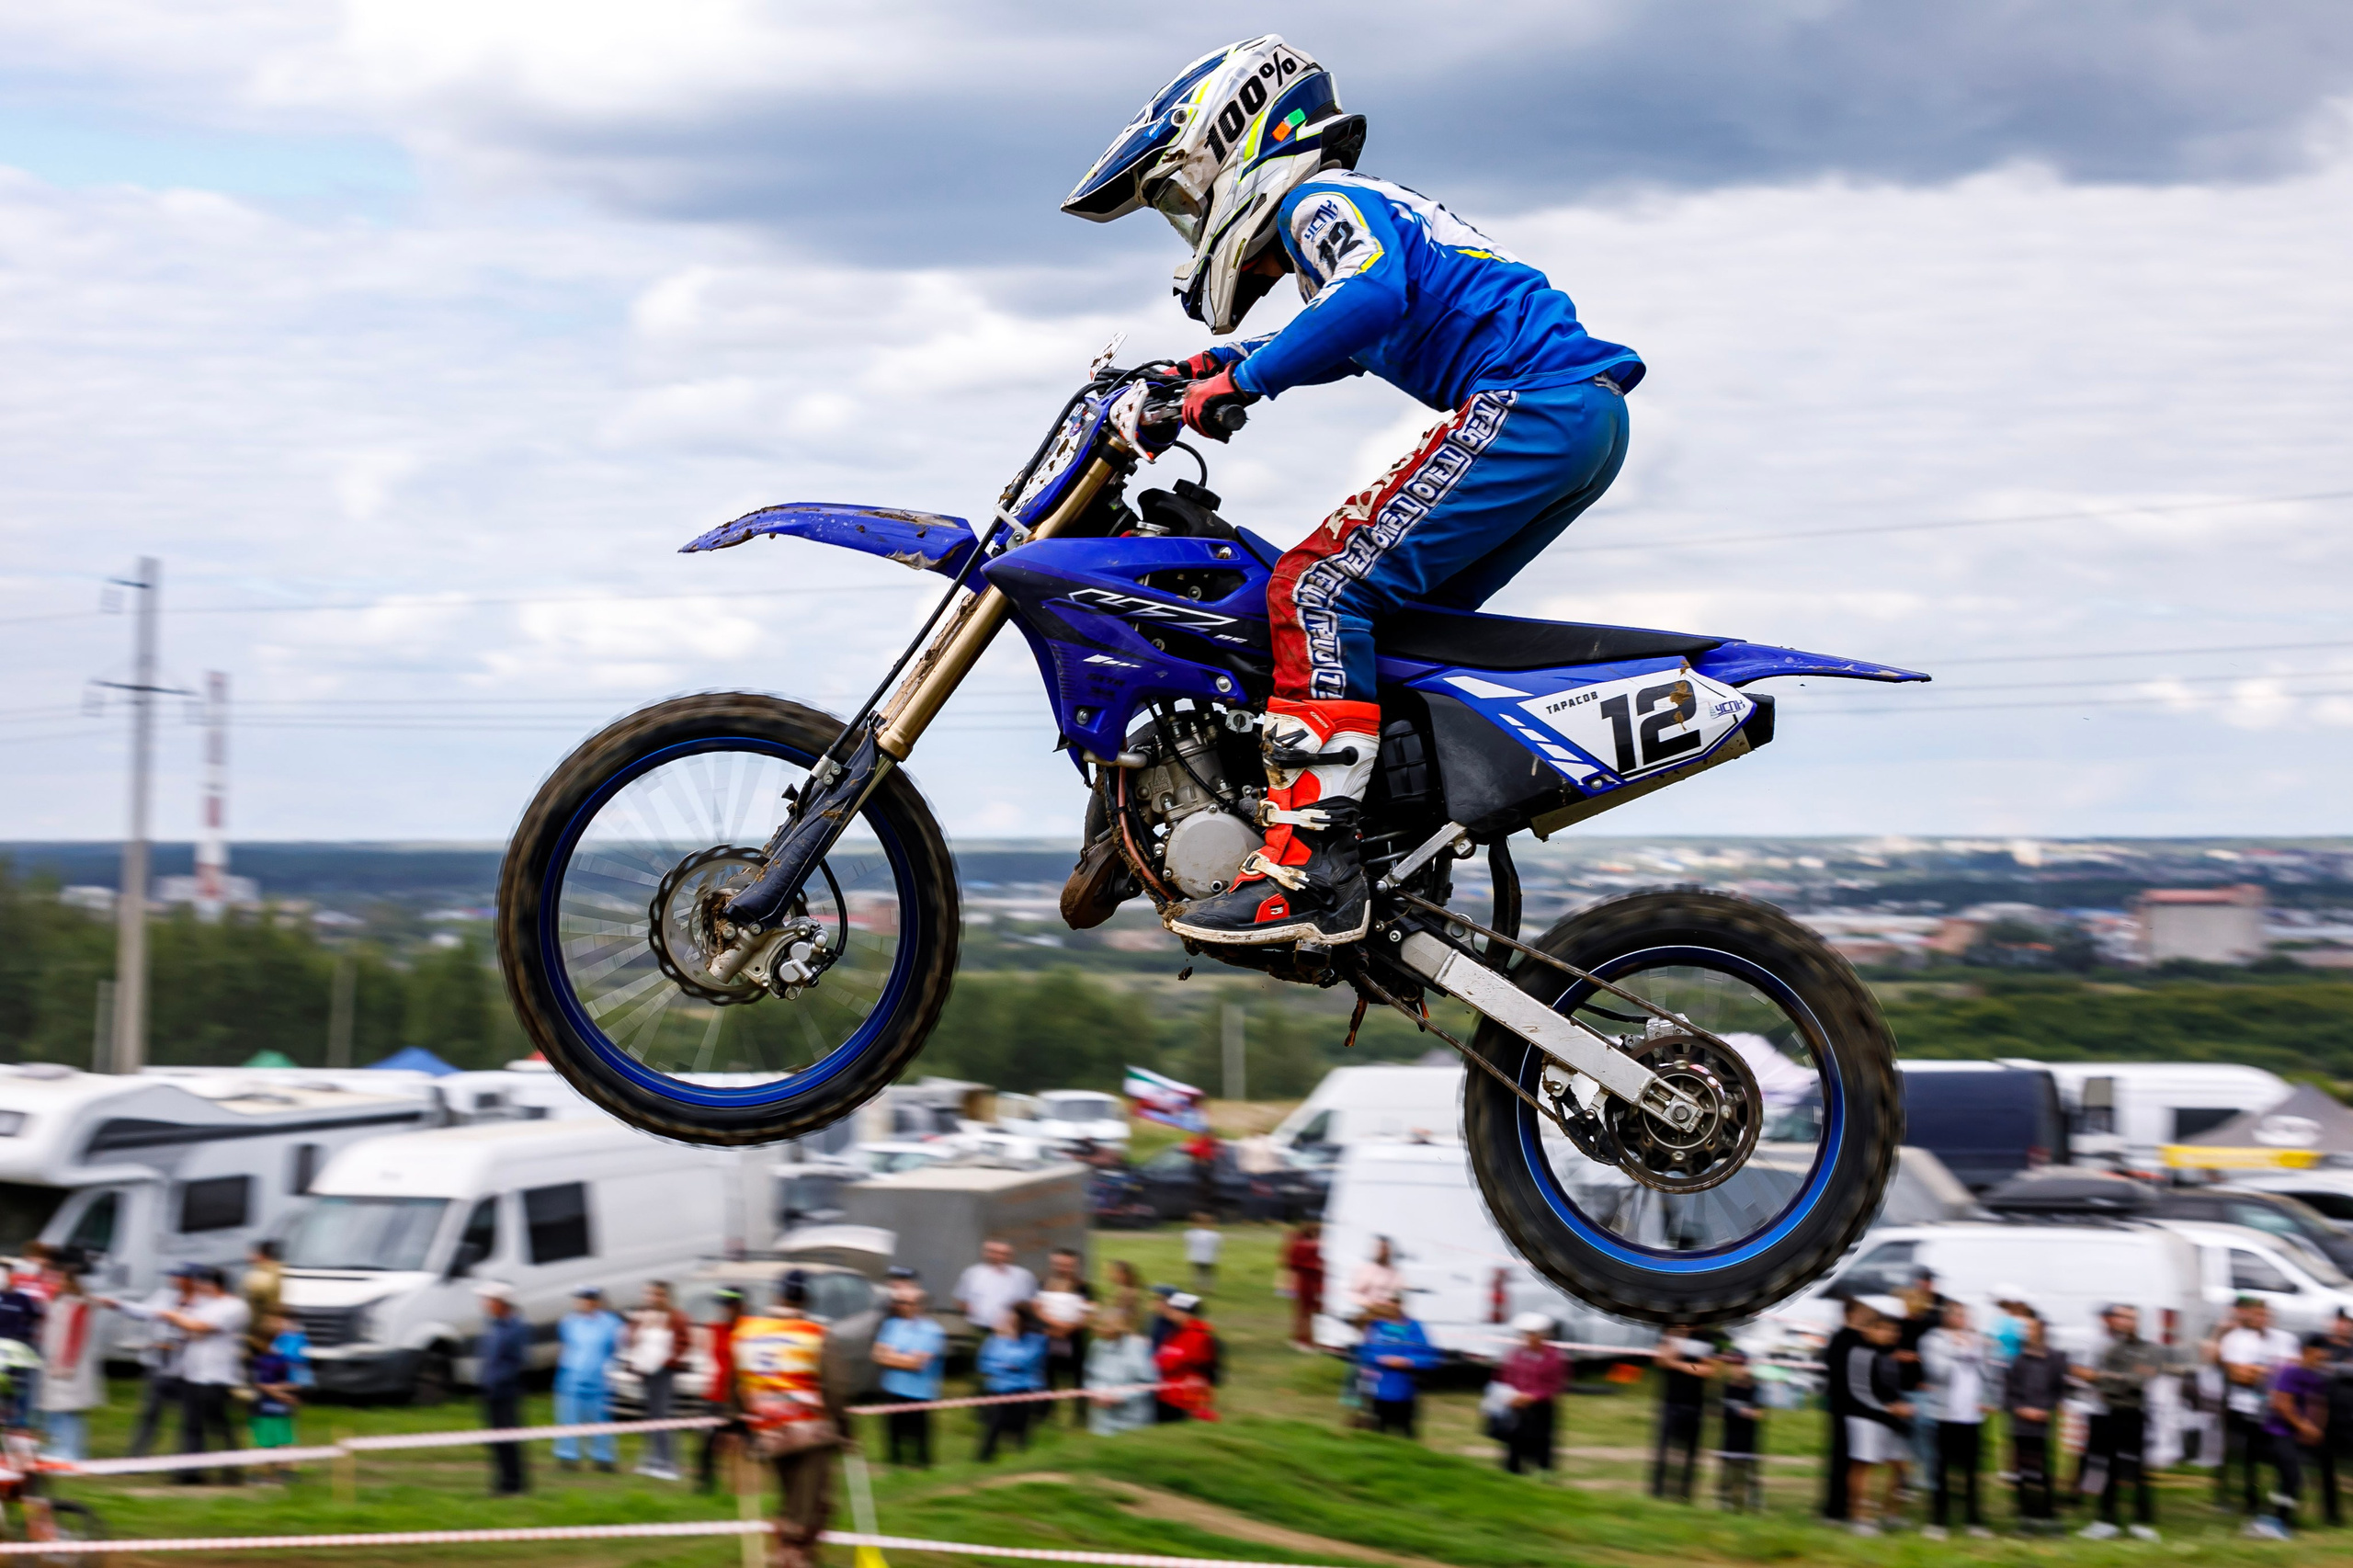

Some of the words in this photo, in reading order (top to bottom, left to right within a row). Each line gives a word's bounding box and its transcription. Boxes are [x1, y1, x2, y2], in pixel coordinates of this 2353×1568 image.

[1204, 51, 1298, 165] 100%
[1320, 221, 1365, 278] 12
[1545, 691, 1598, 714] ТАРАСОВ
[1600, 680, 1701, 772] 12
